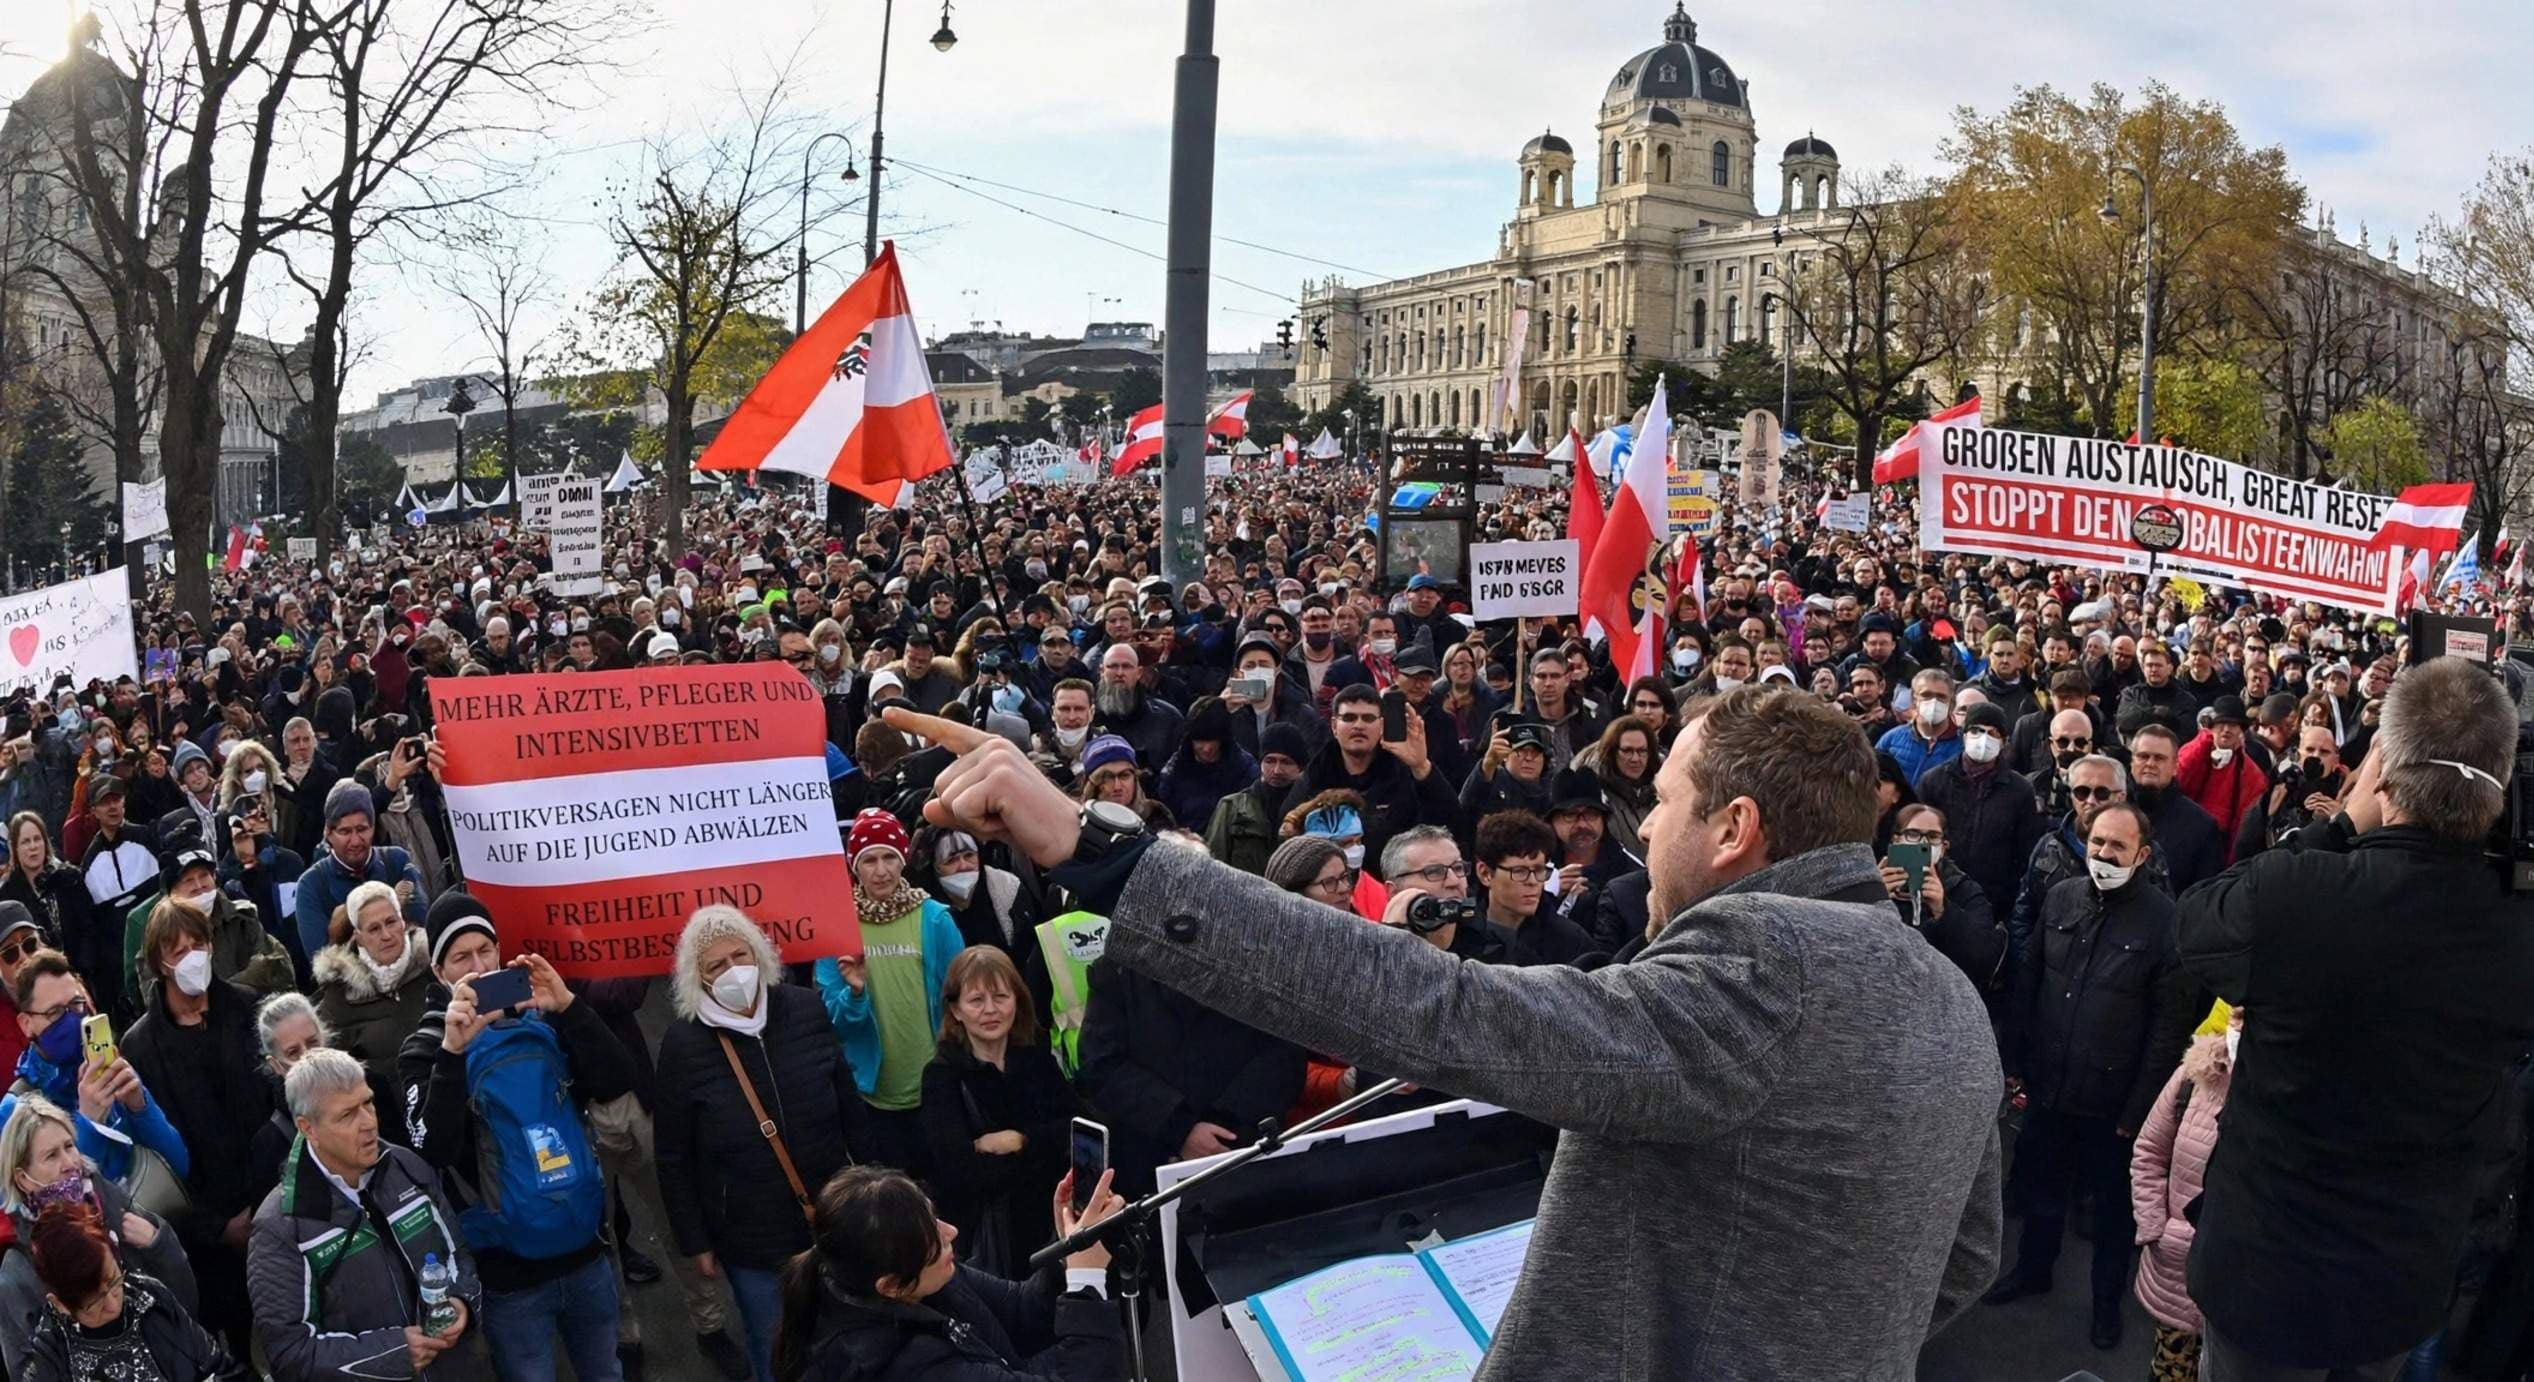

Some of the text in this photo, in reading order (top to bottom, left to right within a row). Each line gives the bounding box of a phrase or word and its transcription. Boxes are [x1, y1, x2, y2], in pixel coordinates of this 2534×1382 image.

[2065, 439, 2235, 508] AUSTAUSCH,
[2243, 470, 2319, 521] GREAT
[1951, 480, 2387, 588] STOPPT DEN OBALISTEENWAHN!
[439, 680, 814, 723] MEHR ÄRZTE, PFLEGER UND
[515, 717, 761, 760] INTENSIVBETTEN
[452, 780, 833, 832] POLITIKVERSAGEN NICHT LÄNGER
[486, 813, 809, 864] AUF DIE JUGEND ABWÄLZEN
[545, 882, 763, 927] FREIHEIT UND
